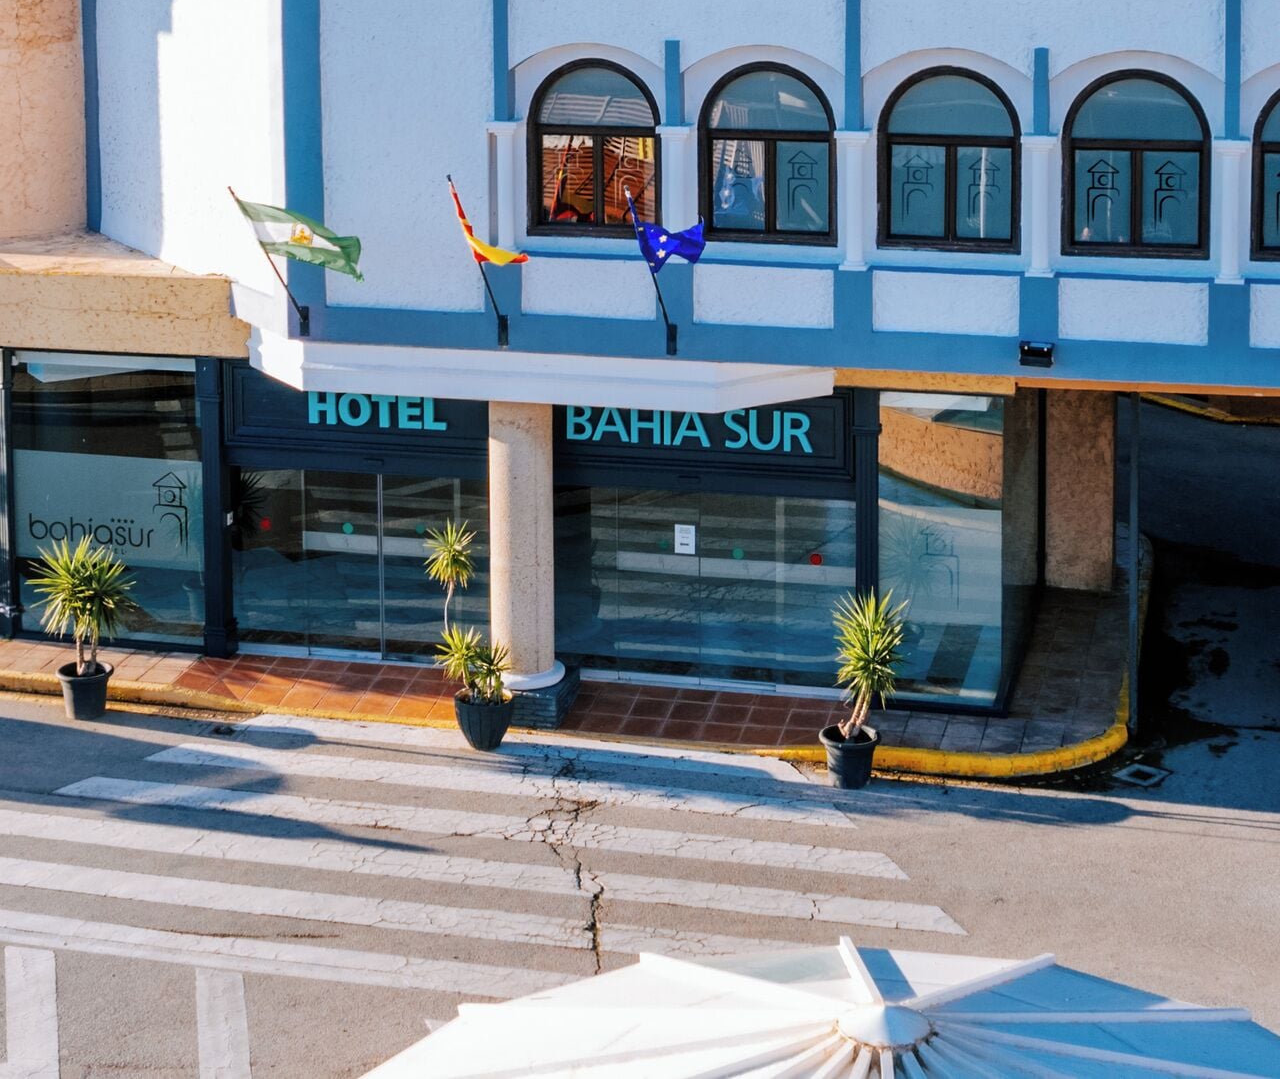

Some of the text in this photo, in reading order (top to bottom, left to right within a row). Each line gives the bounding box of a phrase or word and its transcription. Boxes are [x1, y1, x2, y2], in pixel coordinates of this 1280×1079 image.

[308, 391, 447, 431] HOTEL
[566, 405, 814, 453] BAHIA SUR
